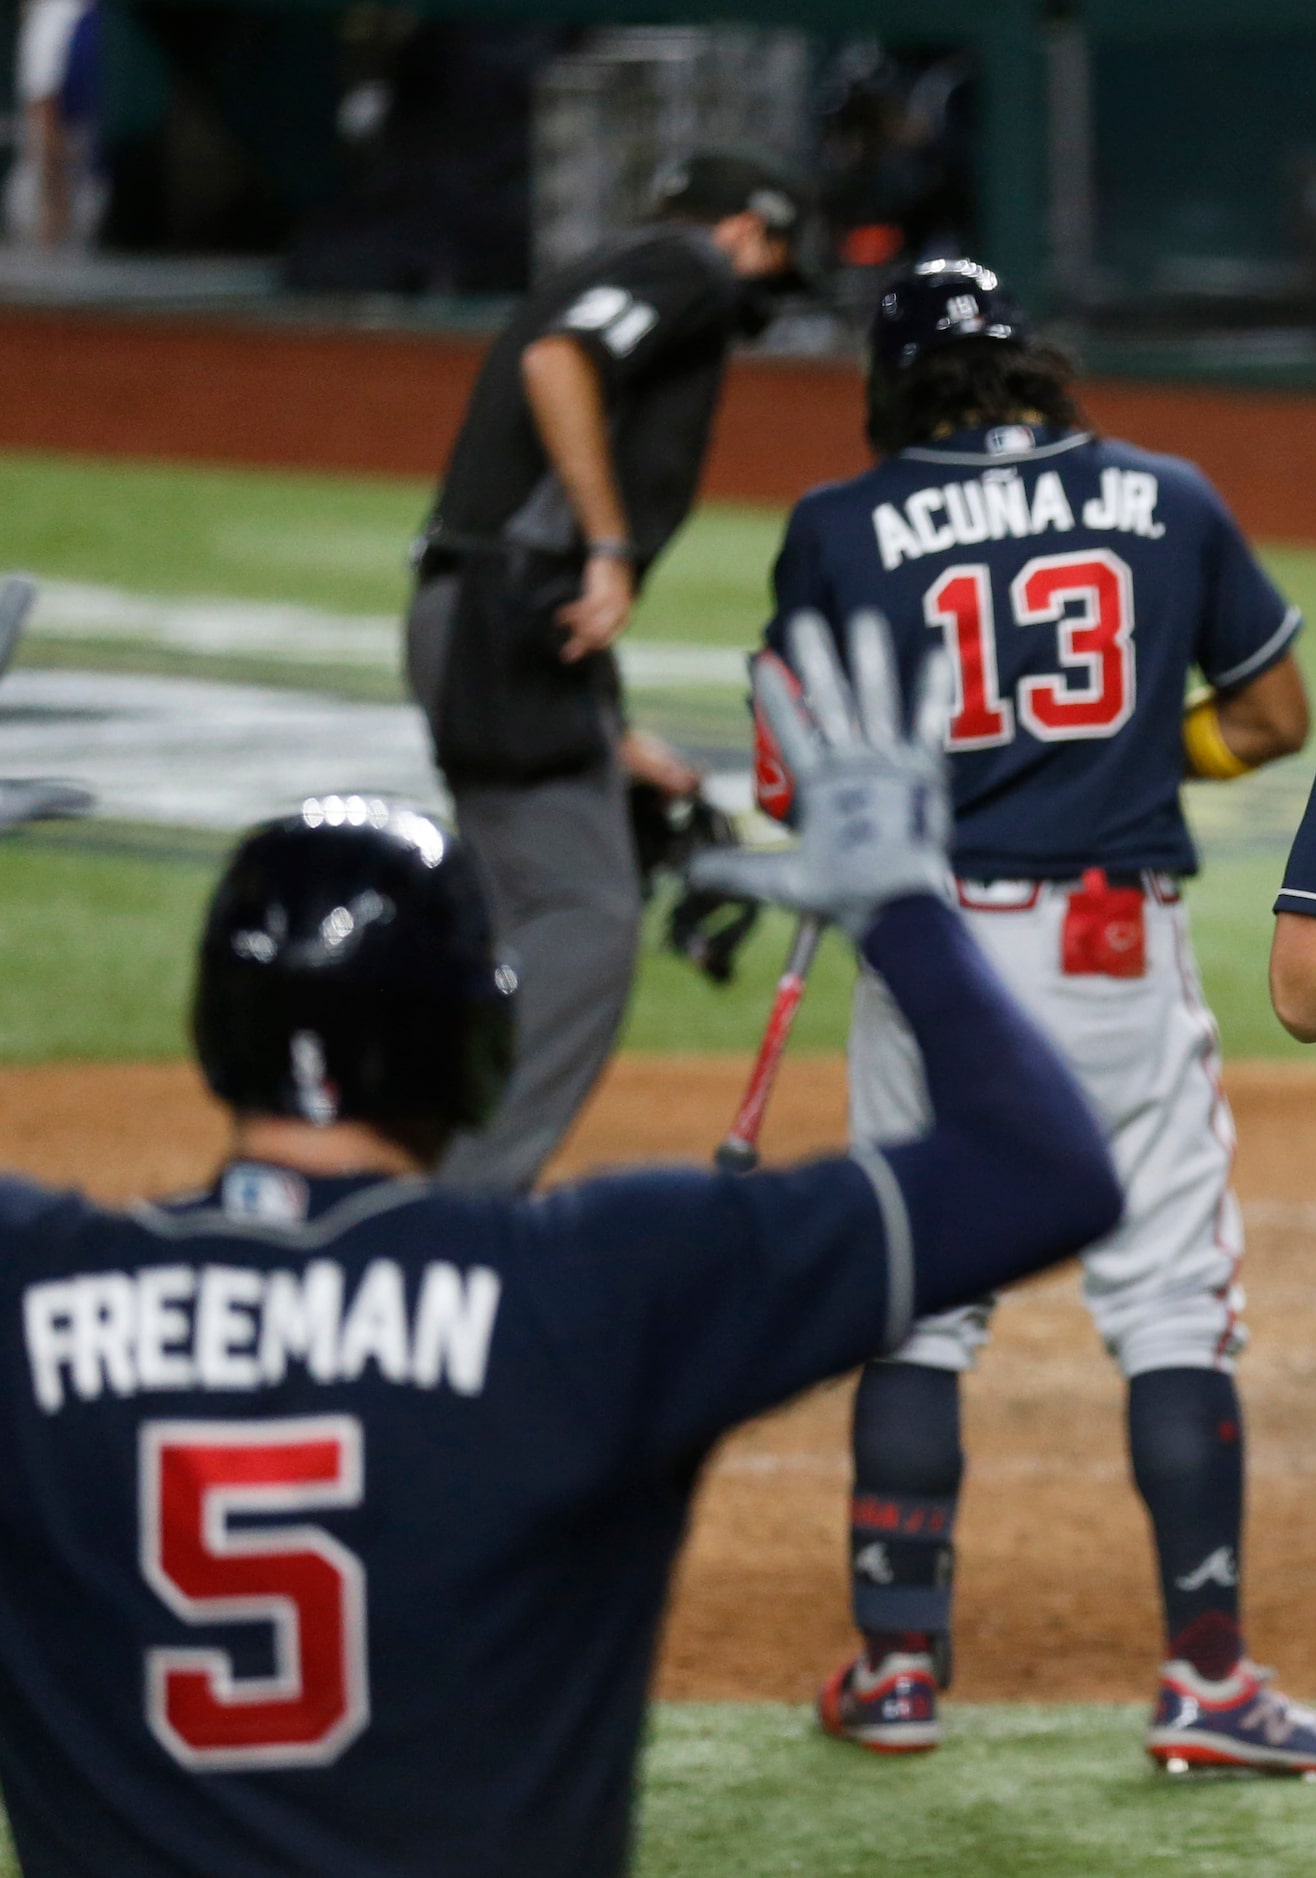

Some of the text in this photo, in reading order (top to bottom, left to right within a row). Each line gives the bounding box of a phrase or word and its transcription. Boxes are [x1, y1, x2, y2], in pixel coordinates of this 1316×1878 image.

[871, 466, 1166, 571] ACUÑA JR.
[923, 548, 1136, 753] 13
[23, 1259, 501, 1414] FREEMAN
[138, 1414, 371, 1775] 5
